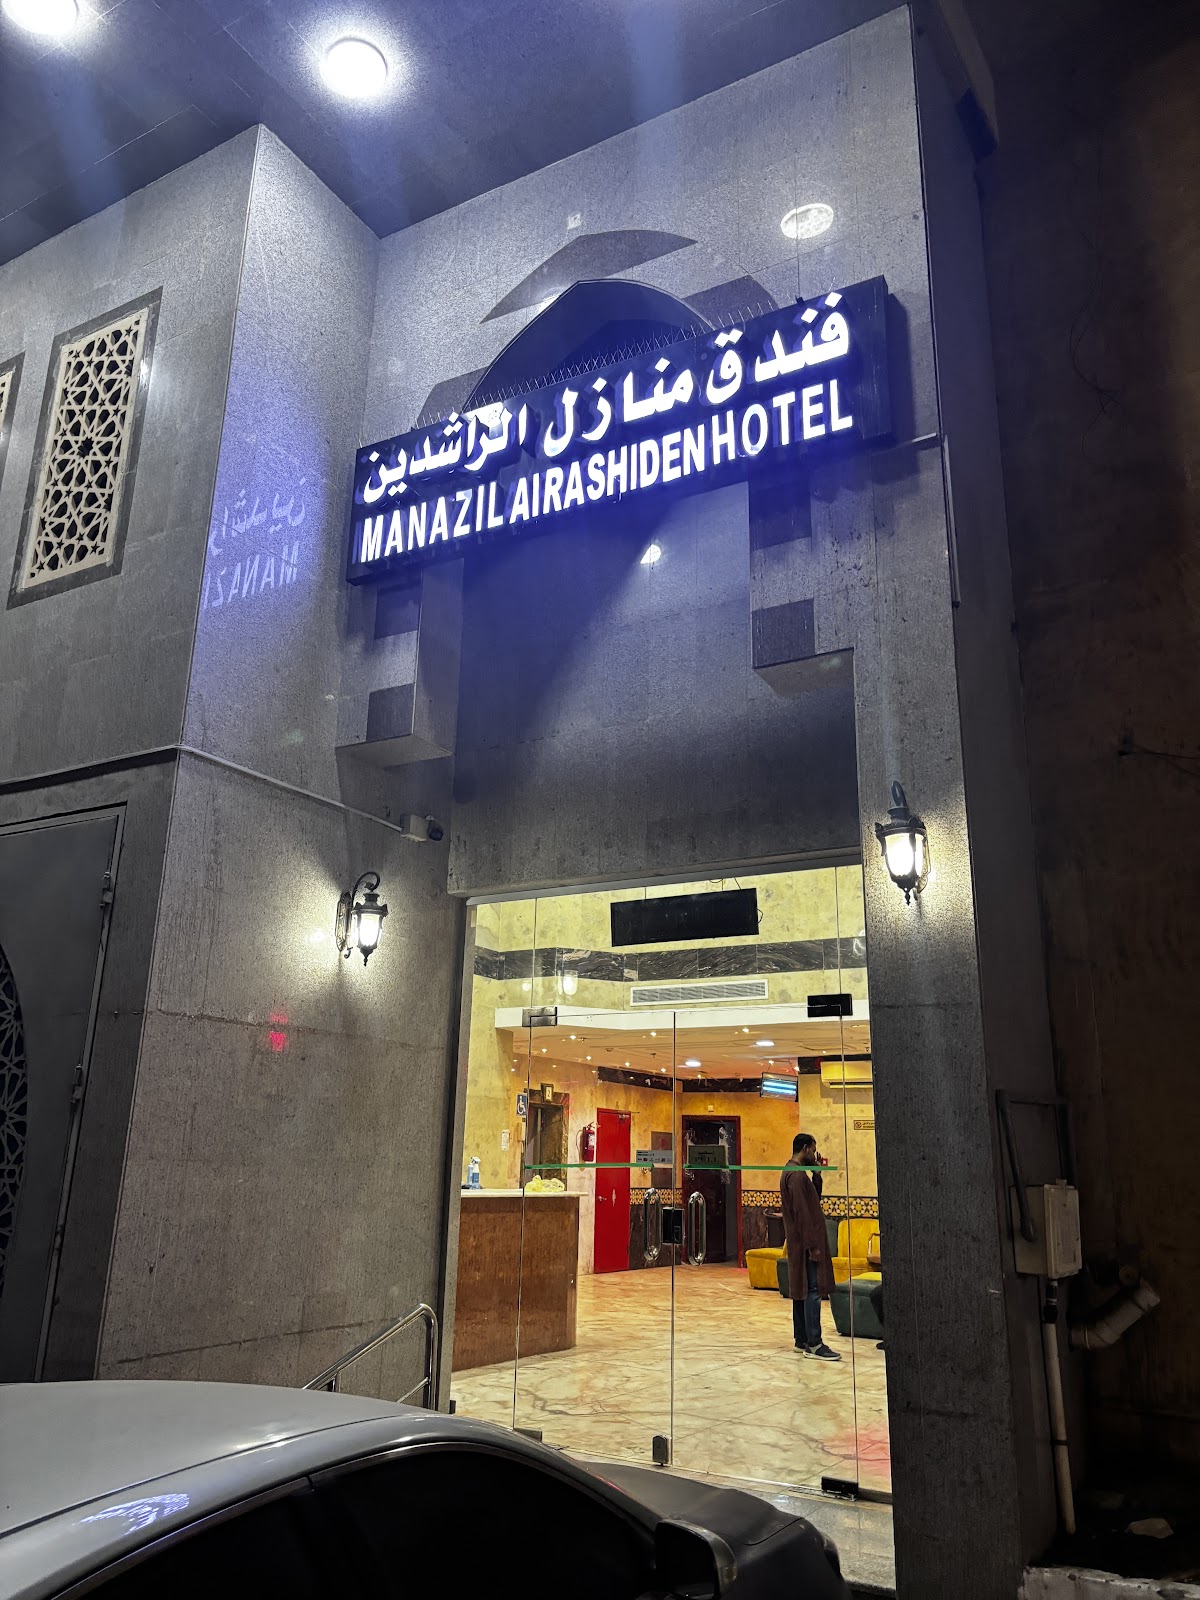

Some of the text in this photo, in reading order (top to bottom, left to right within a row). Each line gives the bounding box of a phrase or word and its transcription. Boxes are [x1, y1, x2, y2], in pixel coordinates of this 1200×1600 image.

[361, 379, 853, 563] MANAZIL AIRASHIDEN HOTEL
[363, 291, 849, 503] فندق منازل الراشدين
